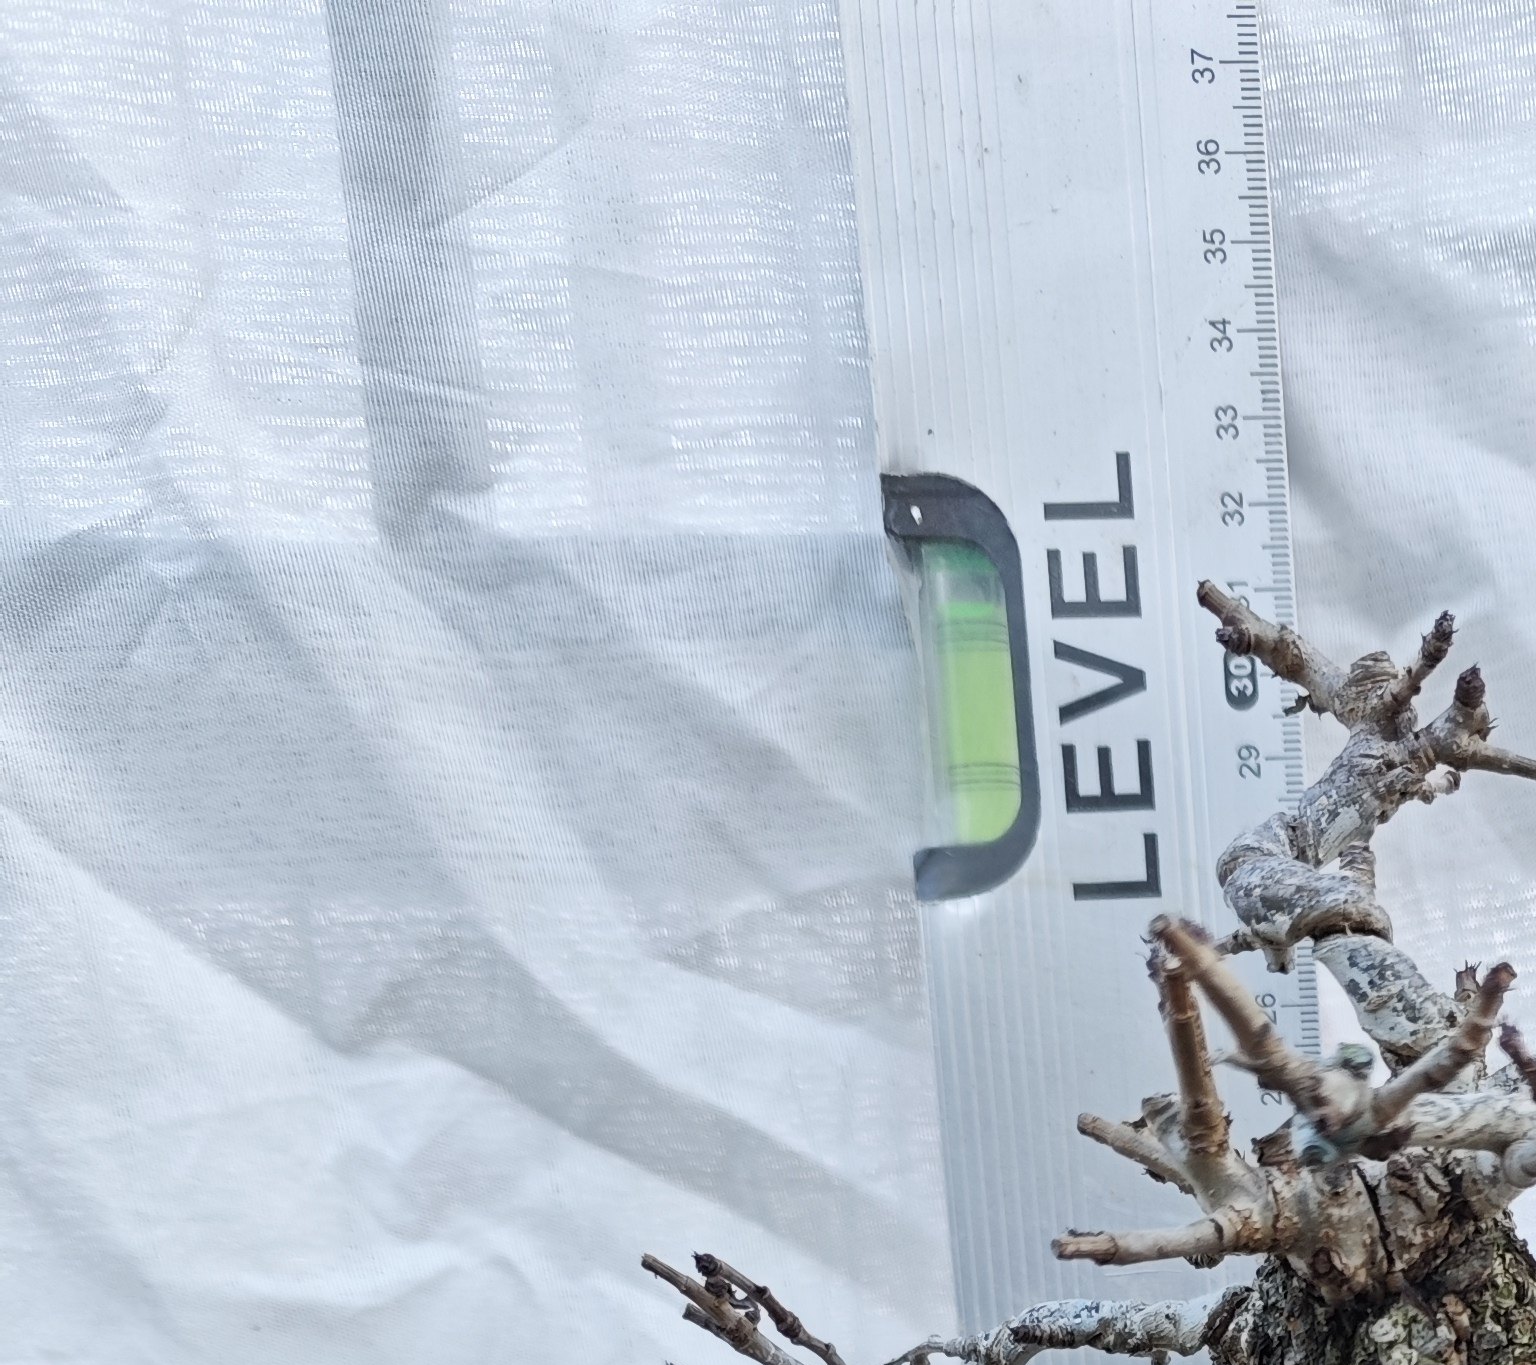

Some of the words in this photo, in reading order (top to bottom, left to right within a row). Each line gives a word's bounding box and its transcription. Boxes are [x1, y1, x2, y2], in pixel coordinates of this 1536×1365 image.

[1190, 47, 1215, 85] 37
[1197, 138, 1222, 176] 36
[1203, 228, 1228, 265] 35
[1208, 317, 1235, 354] 34
[1215, 404, 1239, 441] 33
[1221, 490, 1246, 528] 32
[1043, 451, 1162, 901] LEVEL
[1229, 652, 1255, 699] 30
[1237, 743, 1262, 780] 29
